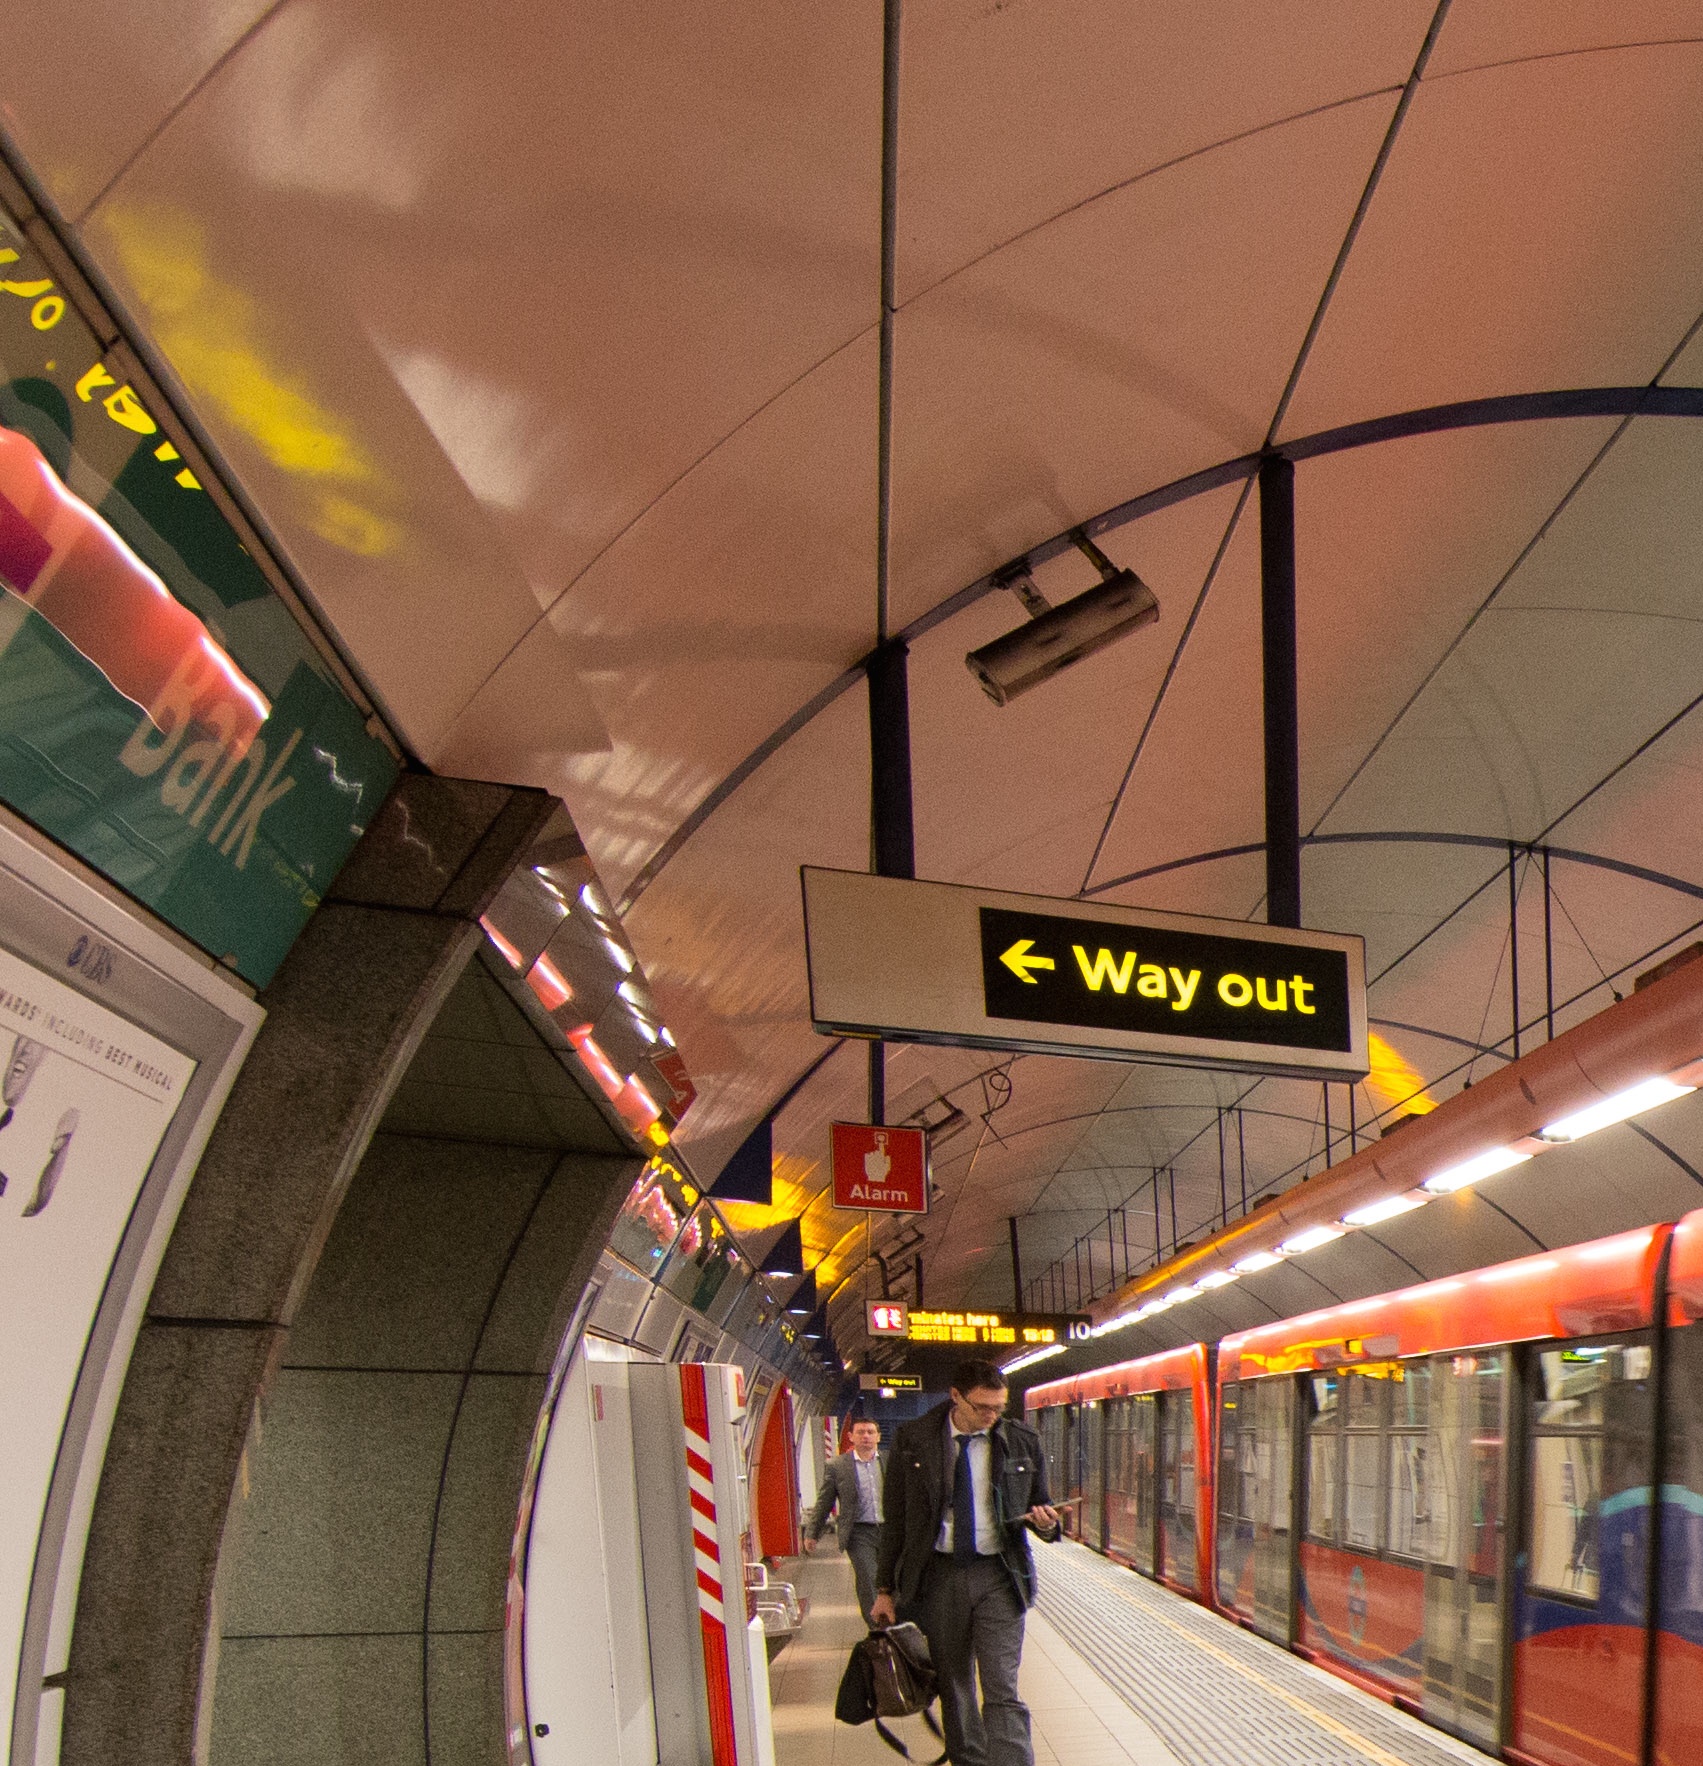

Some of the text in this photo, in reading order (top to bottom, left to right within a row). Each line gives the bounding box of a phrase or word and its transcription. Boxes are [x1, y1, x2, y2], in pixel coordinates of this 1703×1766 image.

[118, 640, 303, 870] Bank
[1072, 945, 1317, 1015] Way out
[42, 1011, 104, 1055] INCLUDING
[105, 1043, 133, 1070] BEST
[134, 1060, 172, 1091] MUSICAL
[850, 1184, 908, 1202] Alarm
[966, 1312, 1000, 1327] here
